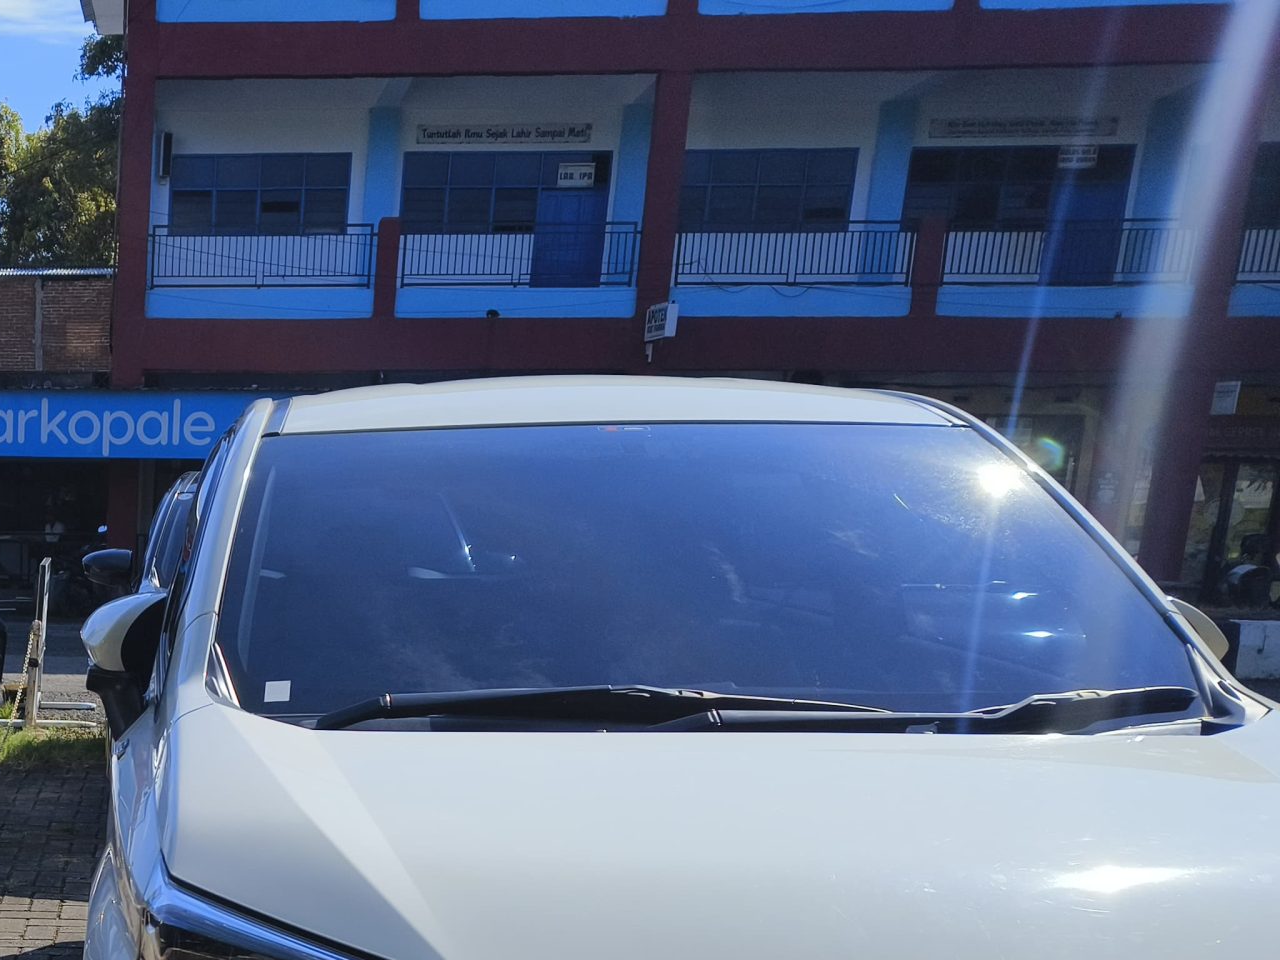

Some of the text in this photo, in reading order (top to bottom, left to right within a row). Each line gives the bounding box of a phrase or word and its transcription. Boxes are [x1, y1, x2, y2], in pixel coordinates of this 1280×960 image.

[485, 128, 508, 141] Sejak
[511, 128, 532, 138] Lahir
[535, 126, 565, 140] Sampai
